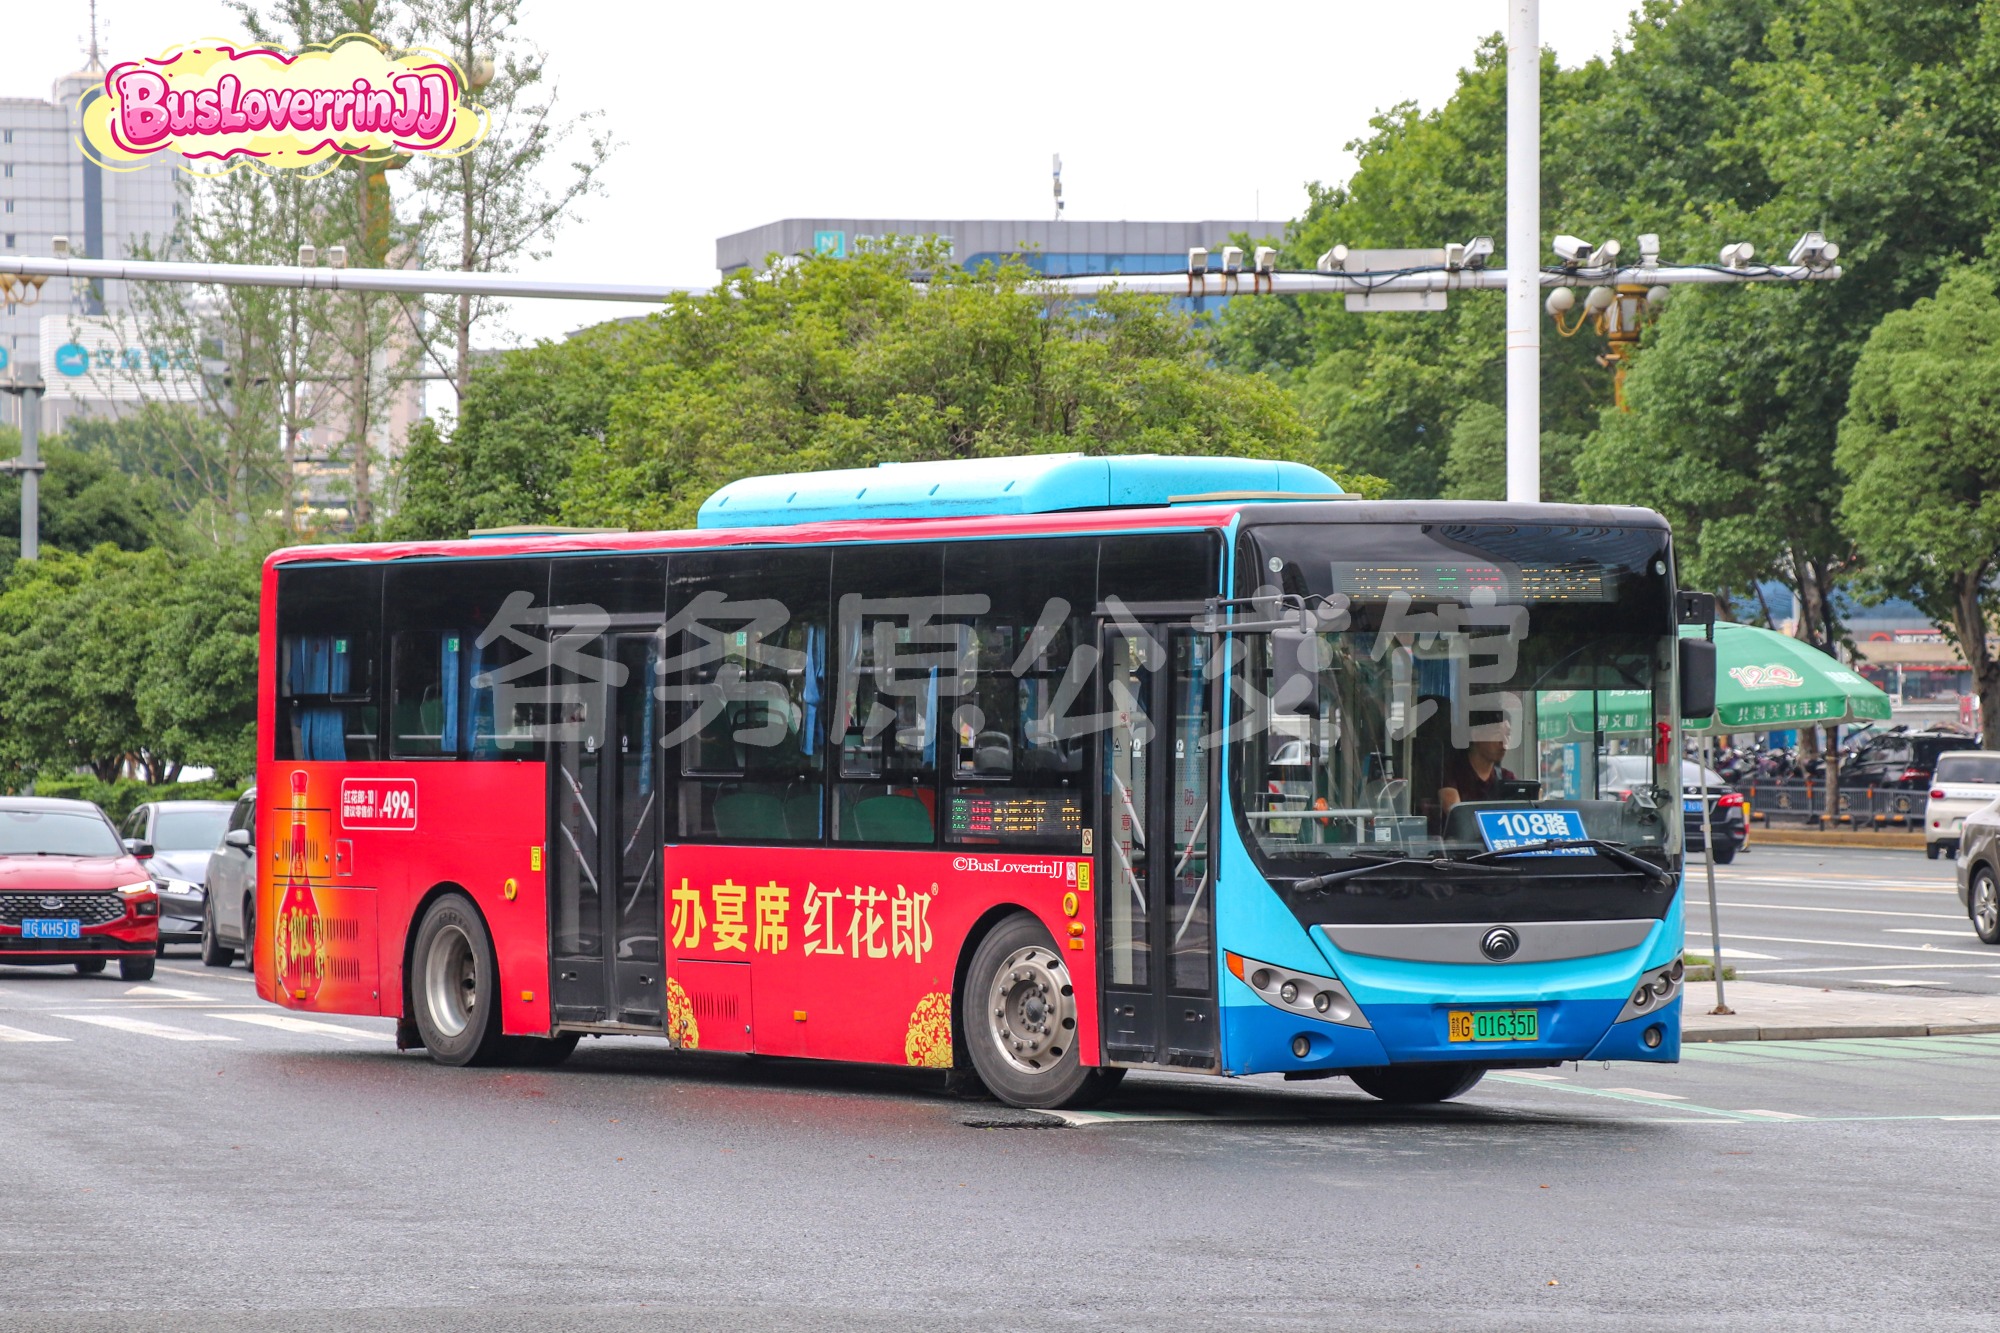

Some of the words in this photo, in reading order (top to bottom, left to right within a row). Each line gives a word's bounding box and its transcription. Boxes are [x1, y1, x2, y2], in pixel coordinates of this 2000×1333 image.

[1497, 813, 1571, 837] 108路
[671, 877, 790, 955] 办宴席
